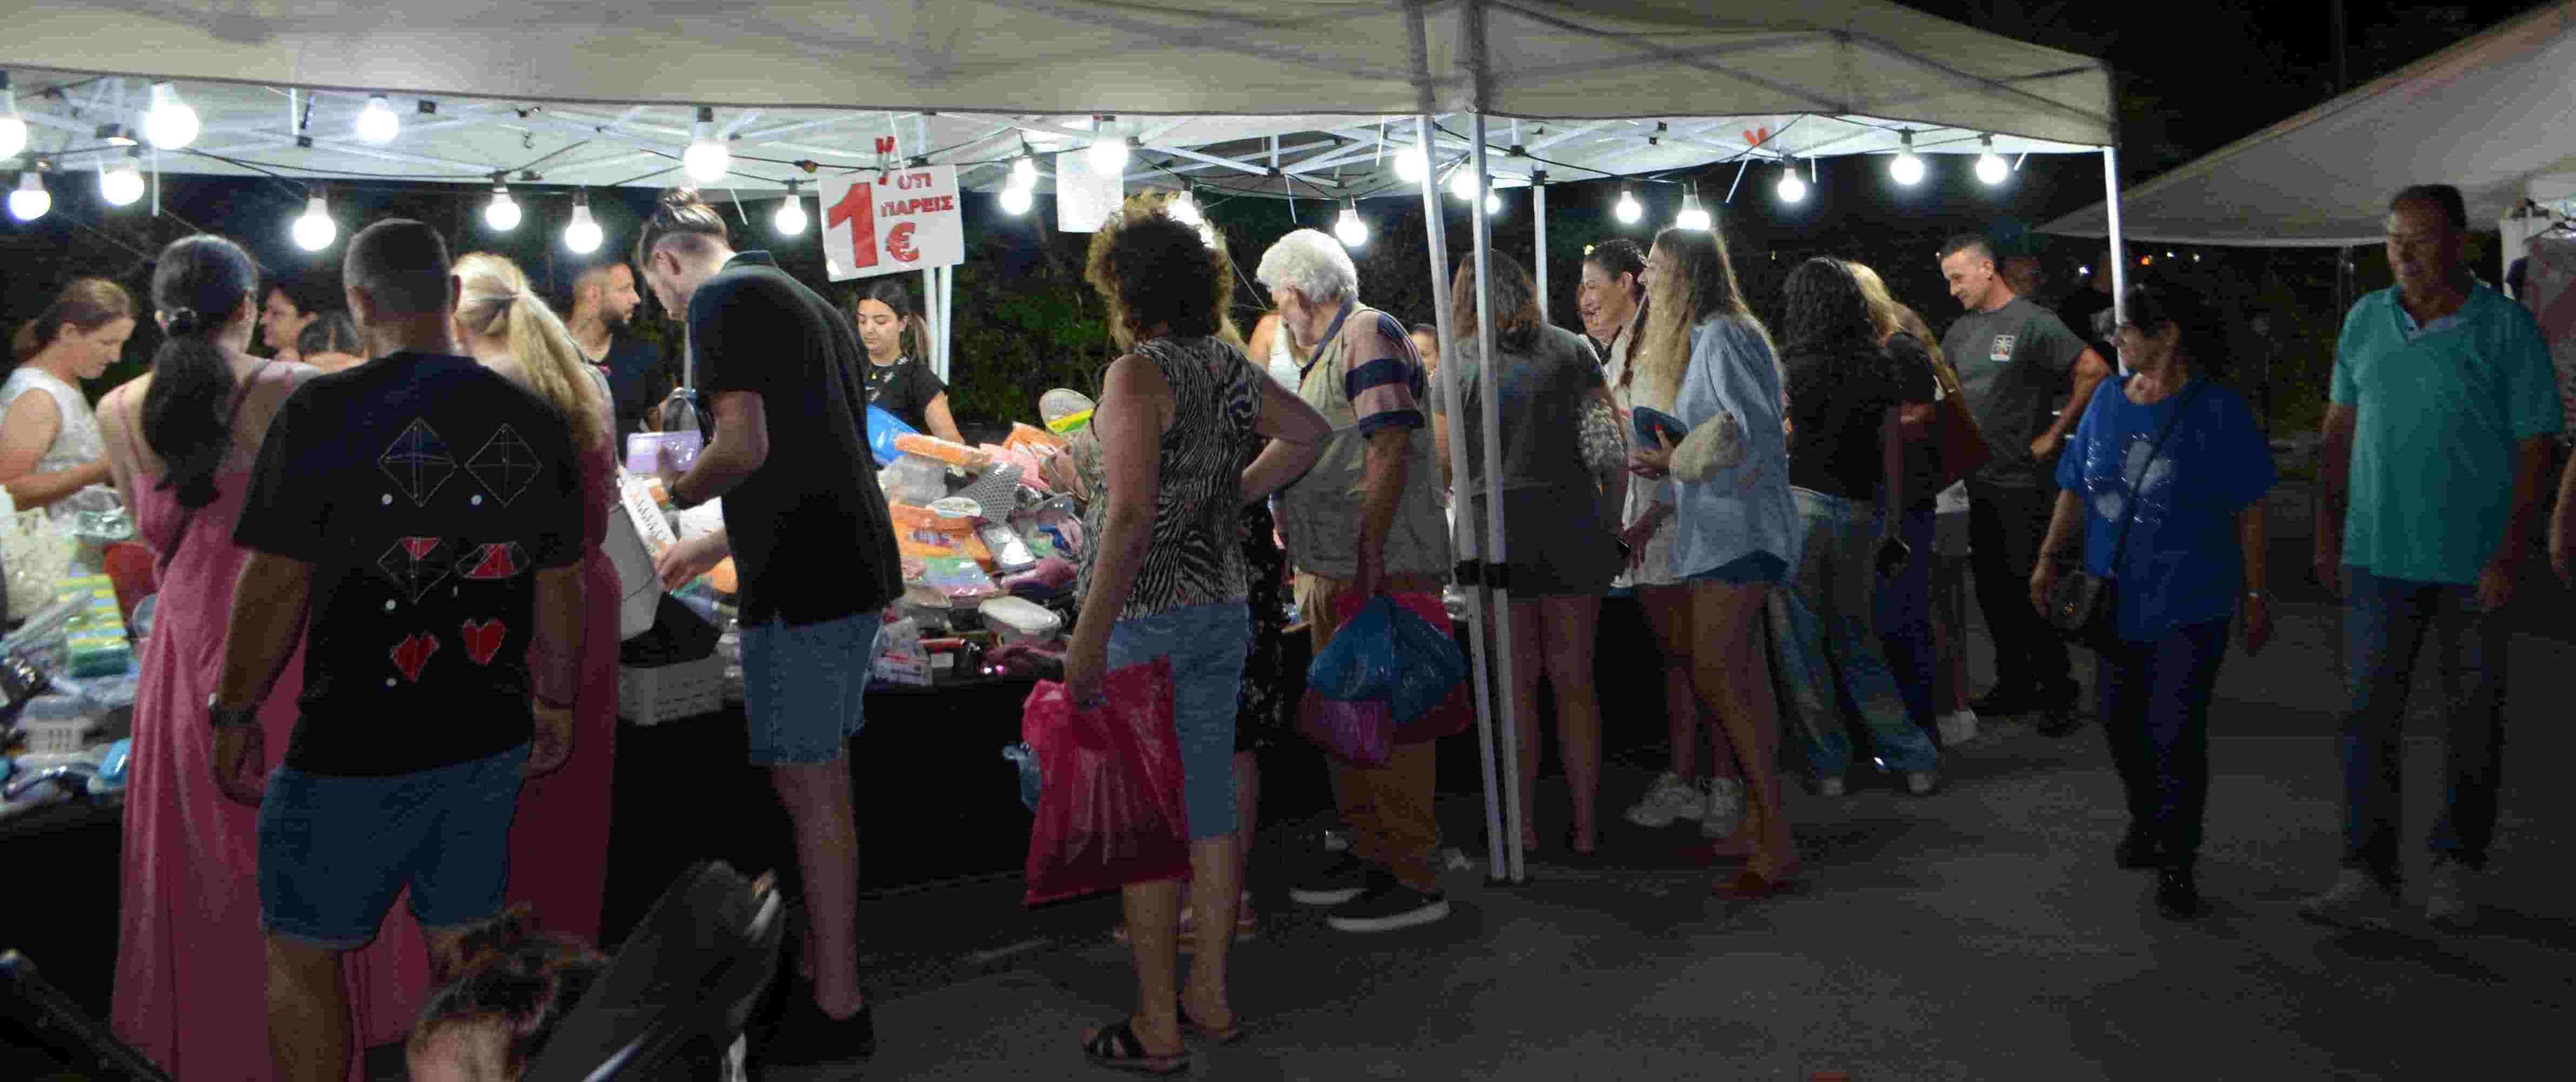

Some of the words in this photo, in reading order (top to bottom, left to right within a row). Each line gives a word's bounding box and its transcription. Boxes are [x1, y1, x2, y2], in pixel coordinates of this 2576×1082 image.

[827, 181, 878, 268] 1
[881, 195, 954, 217] ΠΑΡΕΙΣ
[885, 221, 920, 263] €
